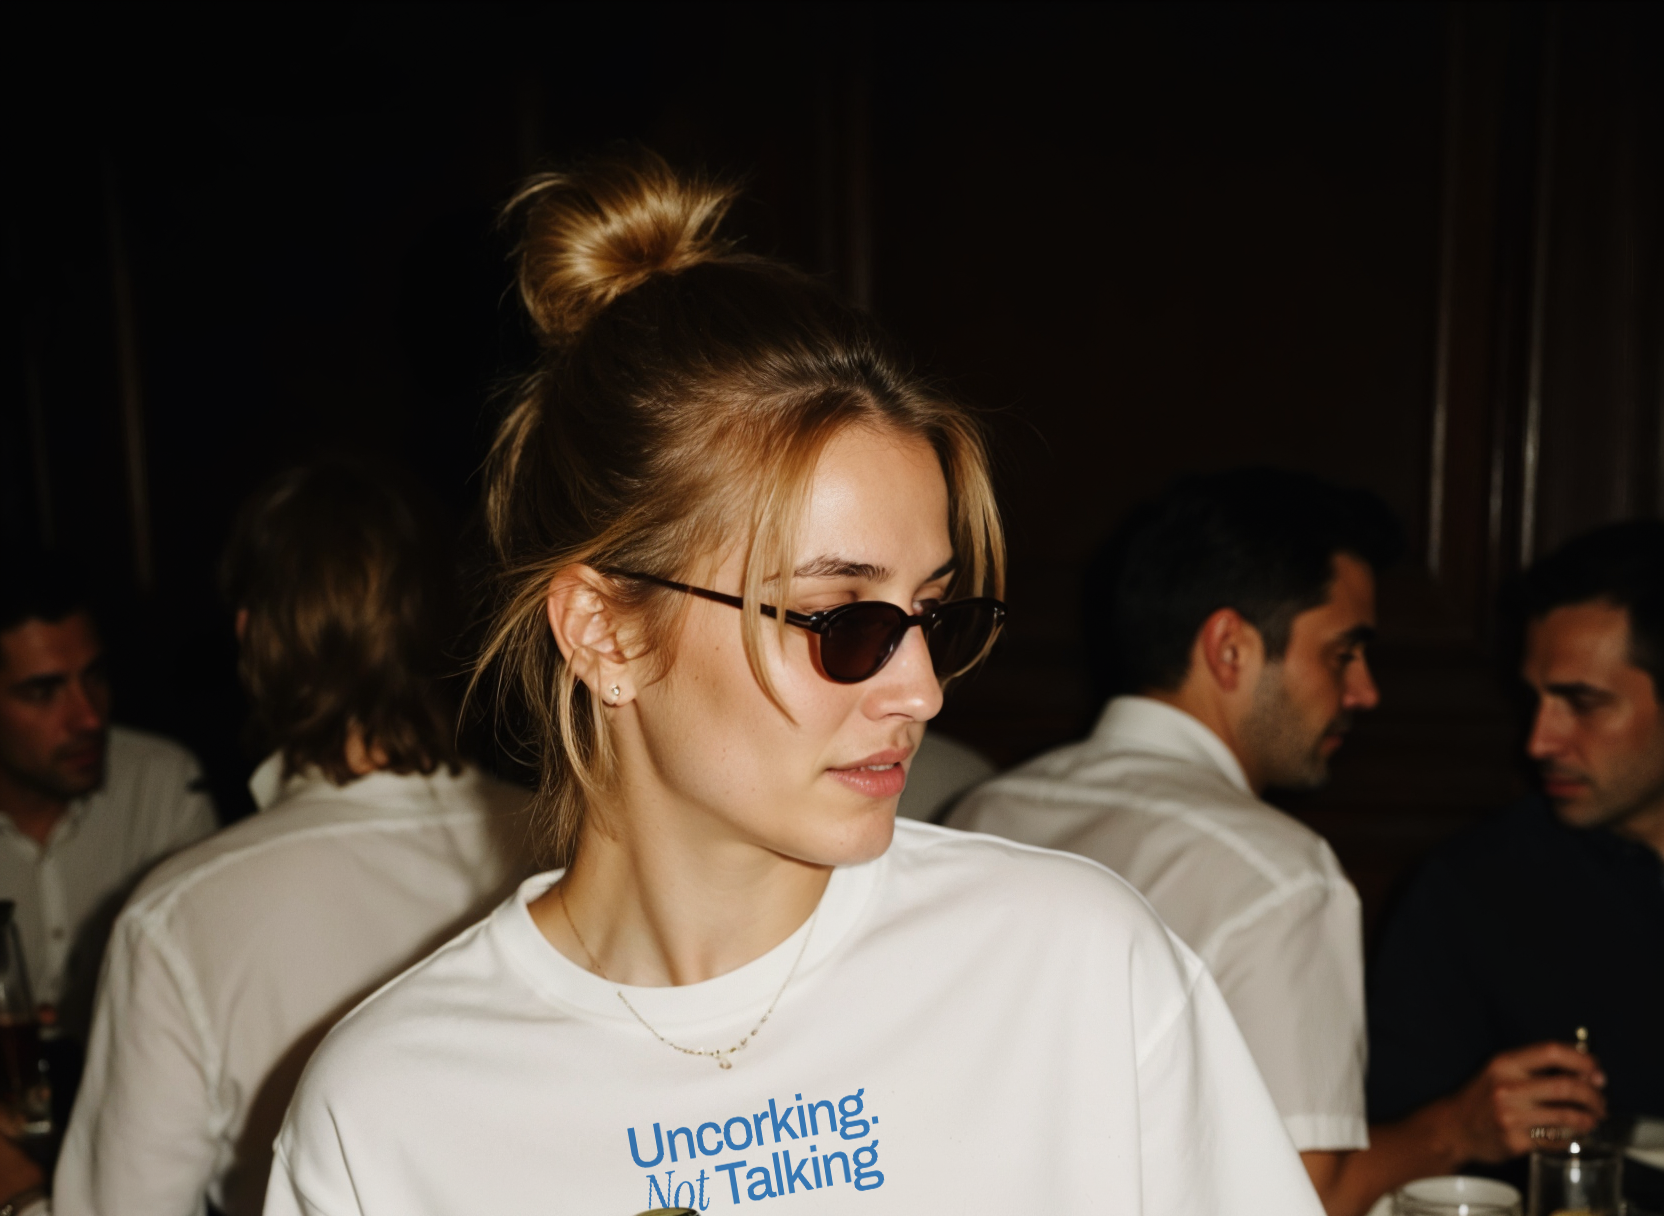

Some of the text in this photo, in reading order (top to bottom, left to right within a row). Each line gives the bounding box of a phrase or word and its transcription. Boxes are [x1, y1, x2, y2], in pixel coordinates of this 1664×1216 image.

[626, 1087, 879, 1168] Uncorking.
[646, 1139, 885, 1212] Not Talking
